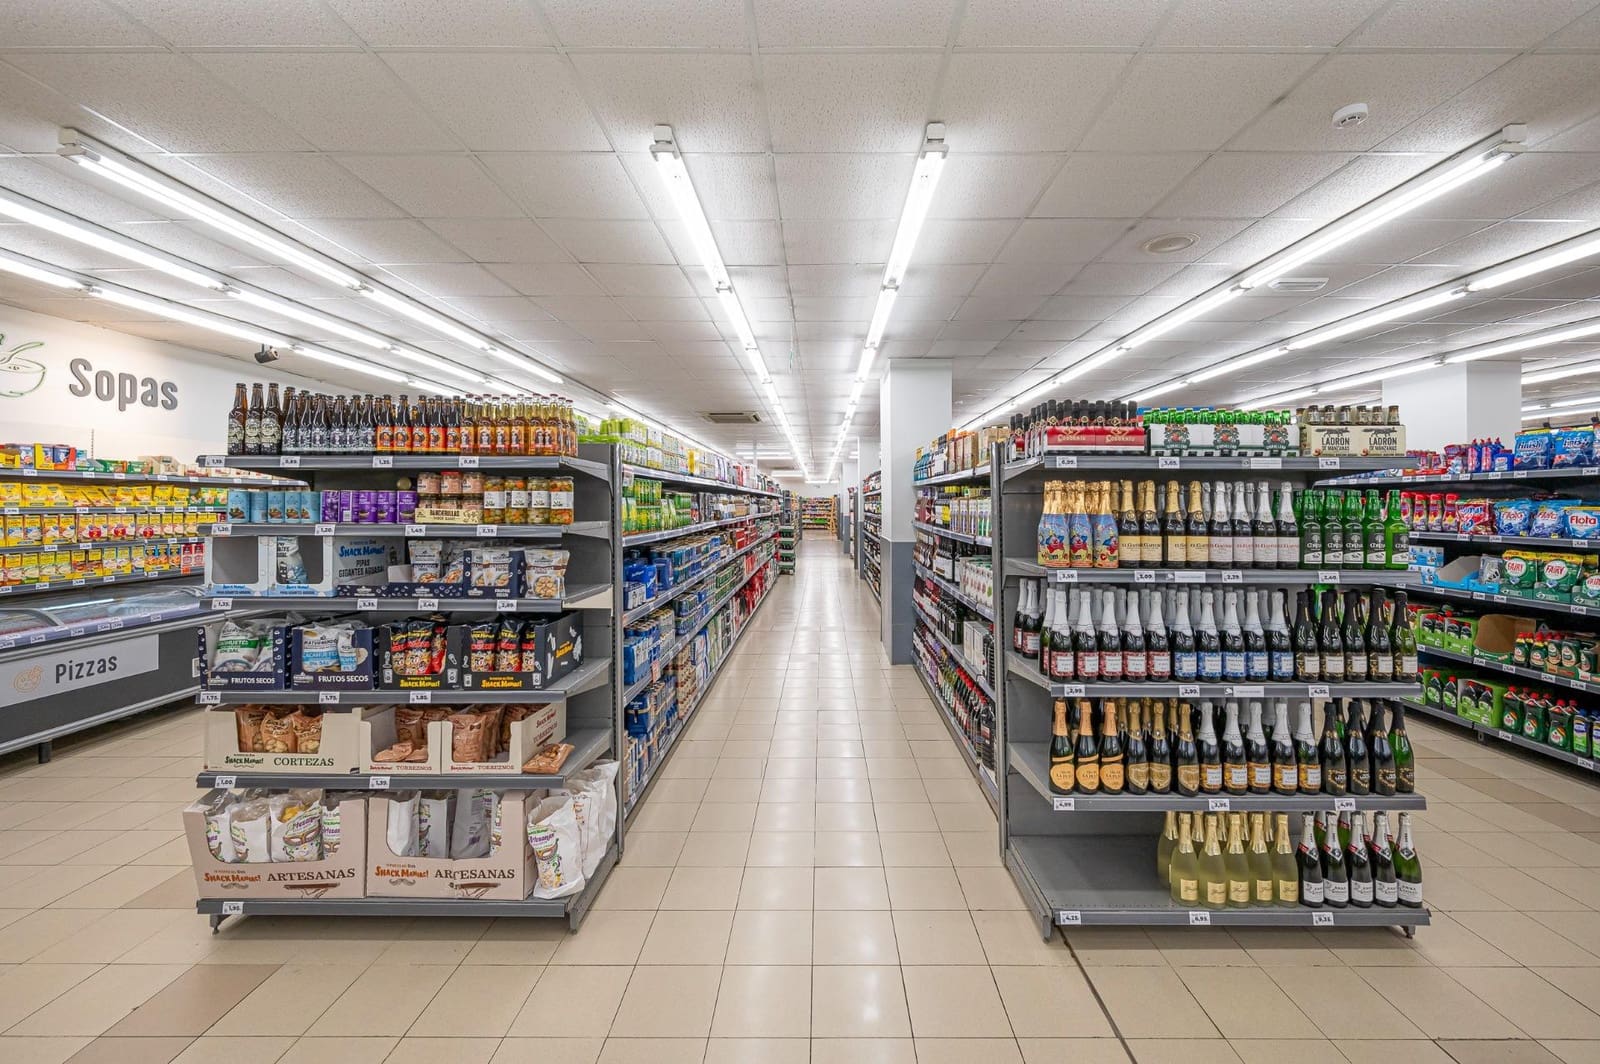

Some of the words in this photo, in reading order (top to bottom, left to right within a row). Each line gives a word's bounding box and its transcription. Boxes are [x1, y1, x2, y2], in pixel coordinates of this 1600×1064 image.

[68, 357, 179, 412] Sopas
[1569, 515, 1597, 525] Flota
[1508, 562, 1524, 571] FAIRY
[1545, 565, 1565, 573] FAIRY
[55, 655, 118, 685] Pizzas
[318, 675, 346, 683] FRUTOS
[273, 757, 335, 767] CORTEZAS
[267, 868, 356, 882] ARTESANAS
[375, 866, 400, 878] SNACK
[204, 873, 231, 882] SNACK
